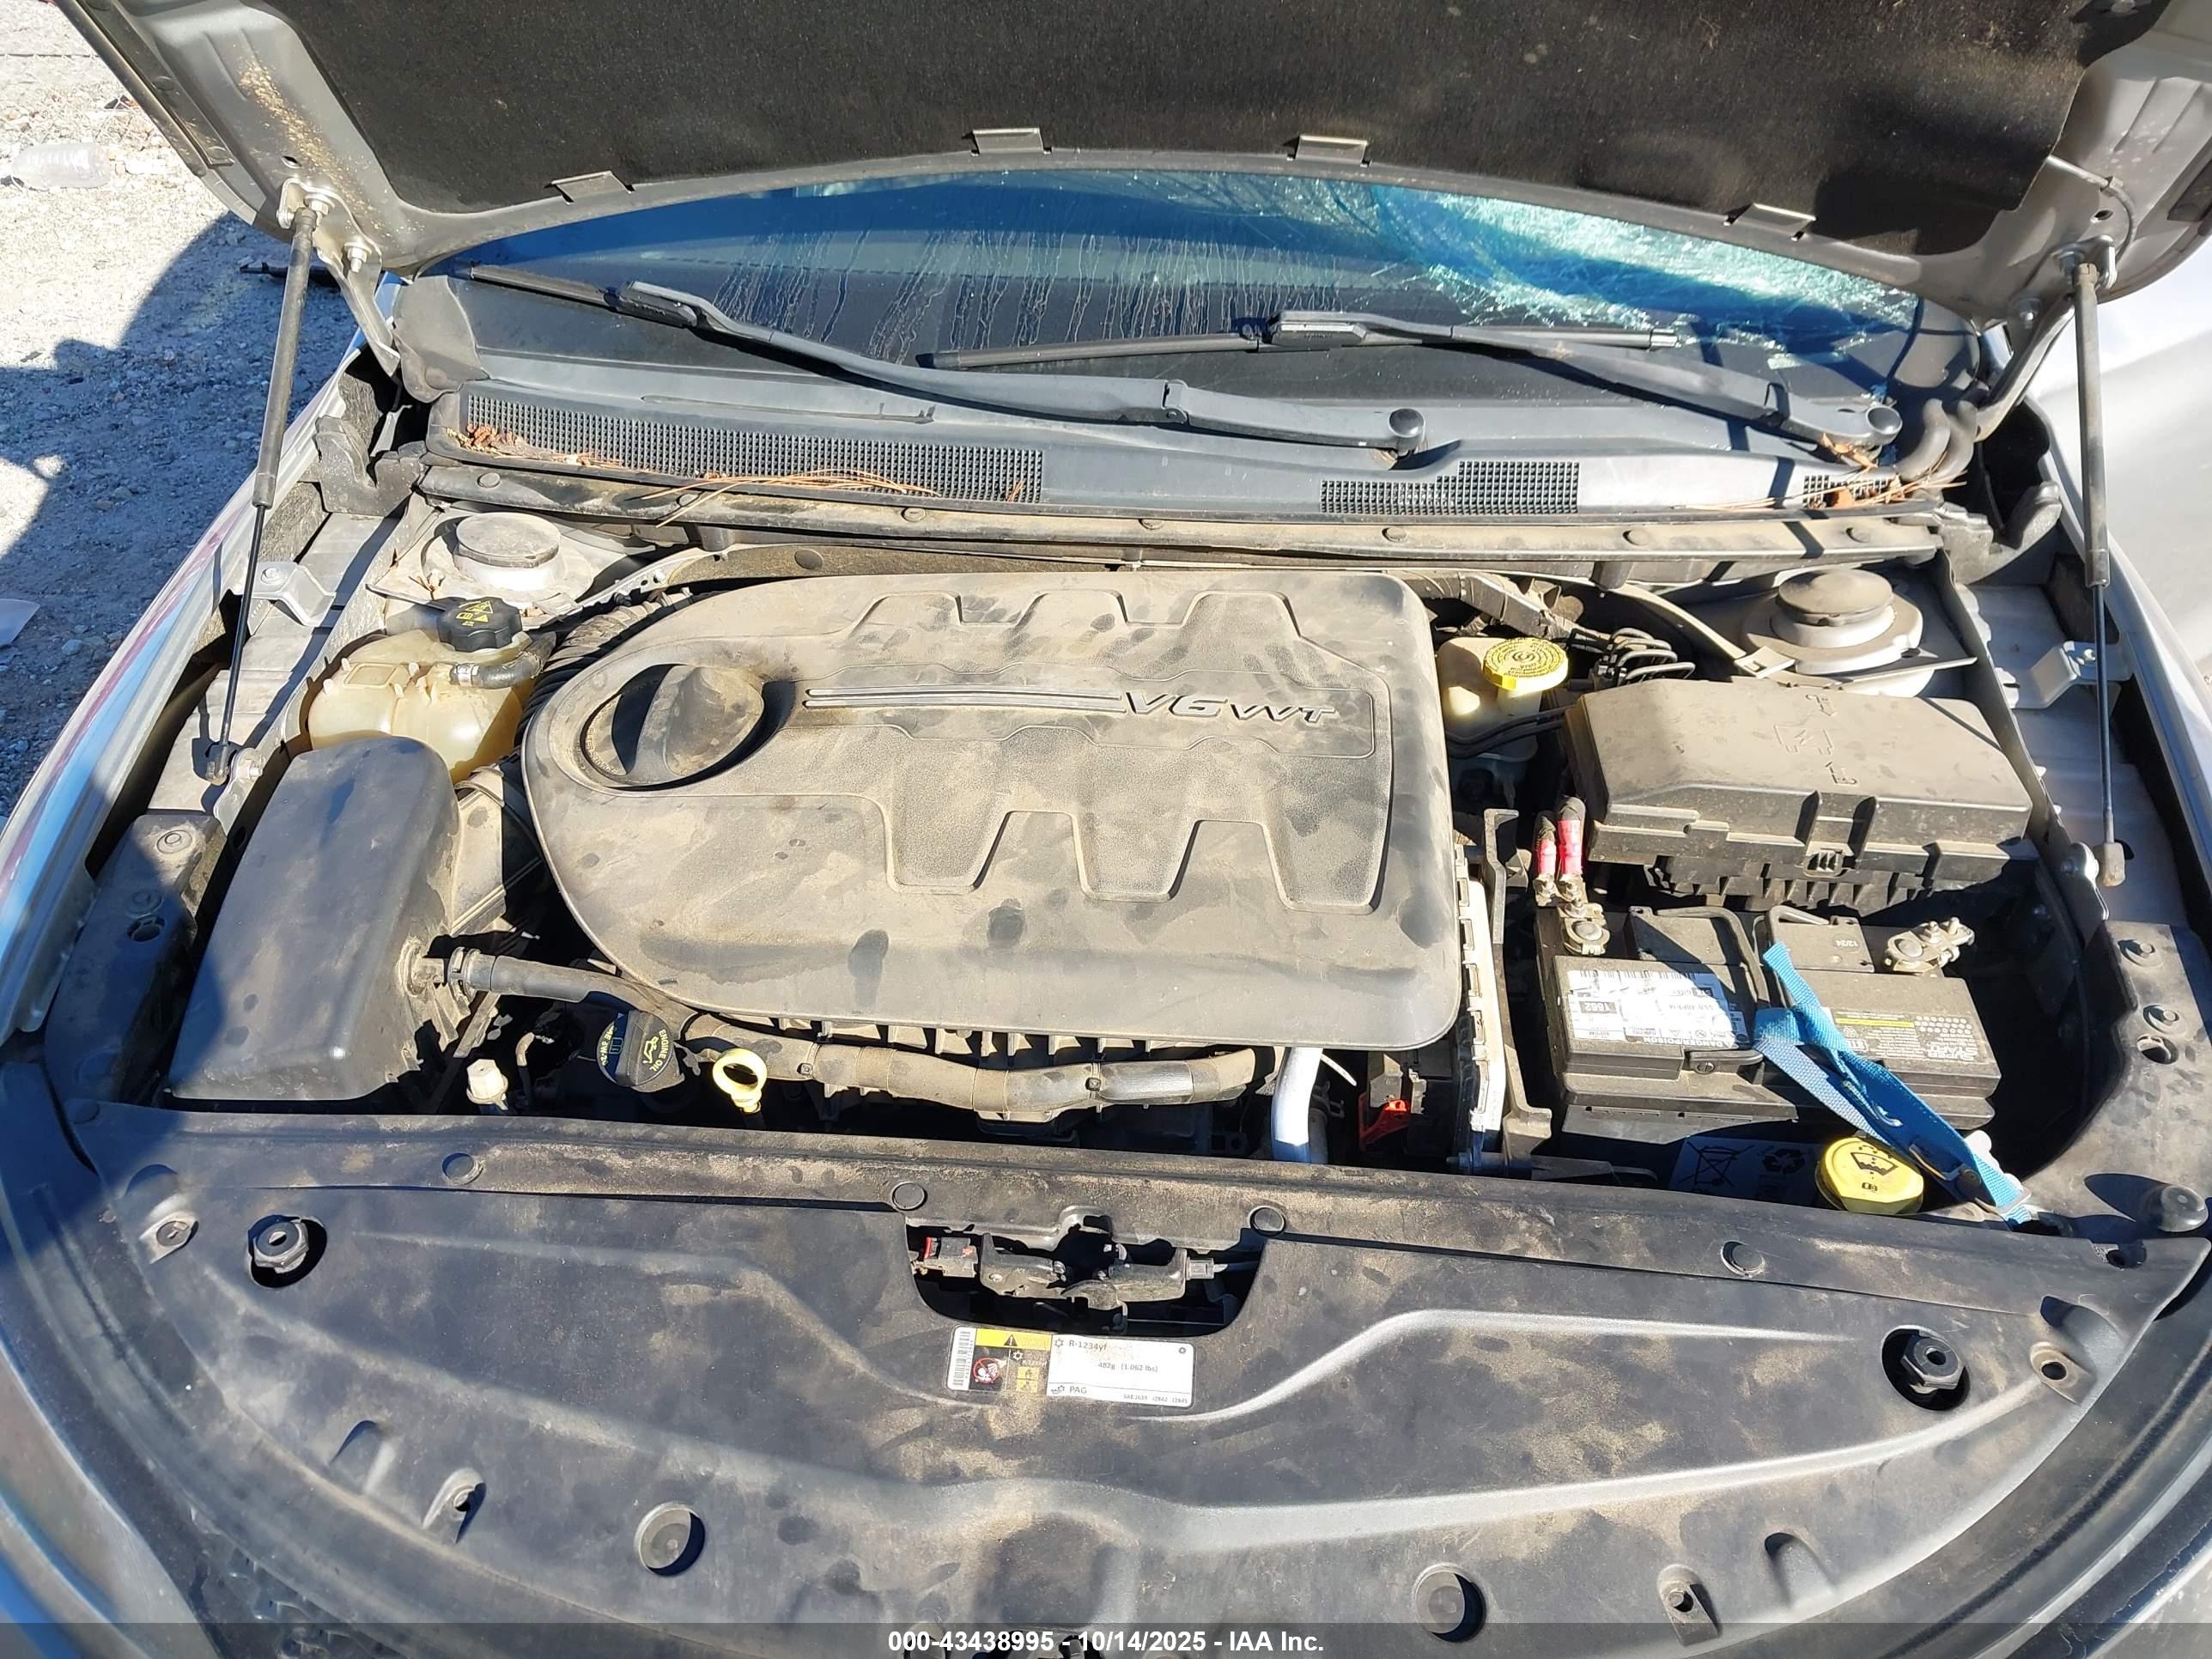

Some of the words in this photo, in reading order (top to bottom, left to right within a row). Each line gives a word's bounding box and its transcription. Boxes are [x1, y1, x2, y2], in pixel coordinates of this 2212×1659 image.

[1126, 690, 1228, 717] V6
[659, 1029, 669, 1059] ENGINE
[1927, 1045, 1978, 1055] START
[1927, 1052, 1975, 1061] SUPER
[649, 1060, 663, 1072] OIL
[1068, 1340, 1108, 1352] R-1234yf
[1069, 1385, 1087, 1395] PAG
